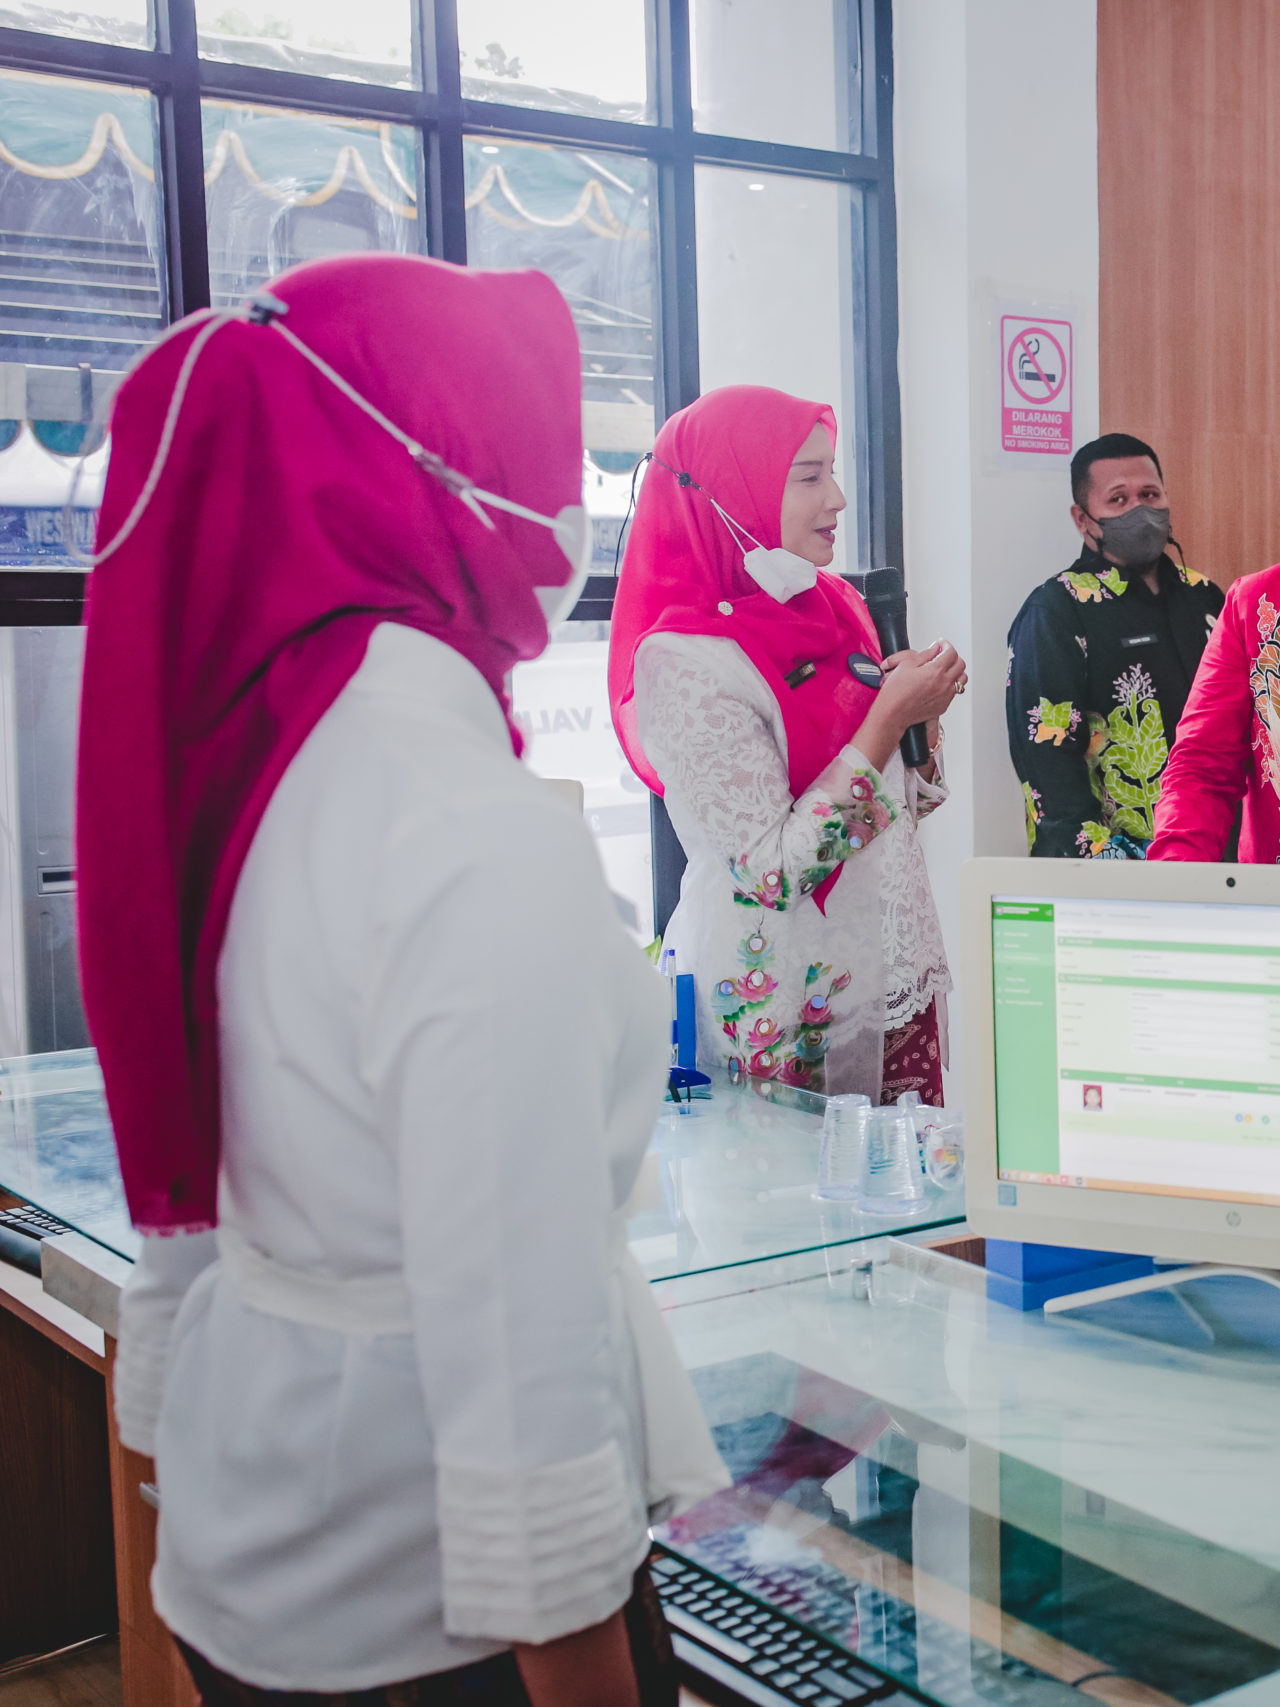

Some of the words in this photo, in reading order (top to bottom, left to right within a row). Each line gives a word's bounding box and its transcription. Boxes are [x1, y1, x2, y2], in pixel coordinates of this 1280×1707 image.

[1012, 410, 1063, 425] DILARANG
[1012, 424, 1062, 438] MEROKOK
[1004, 438, 1016, 447] NO
[1018, 439, 1050, 450] SMOKING
[1051, 441, 1070, 451] AREA
